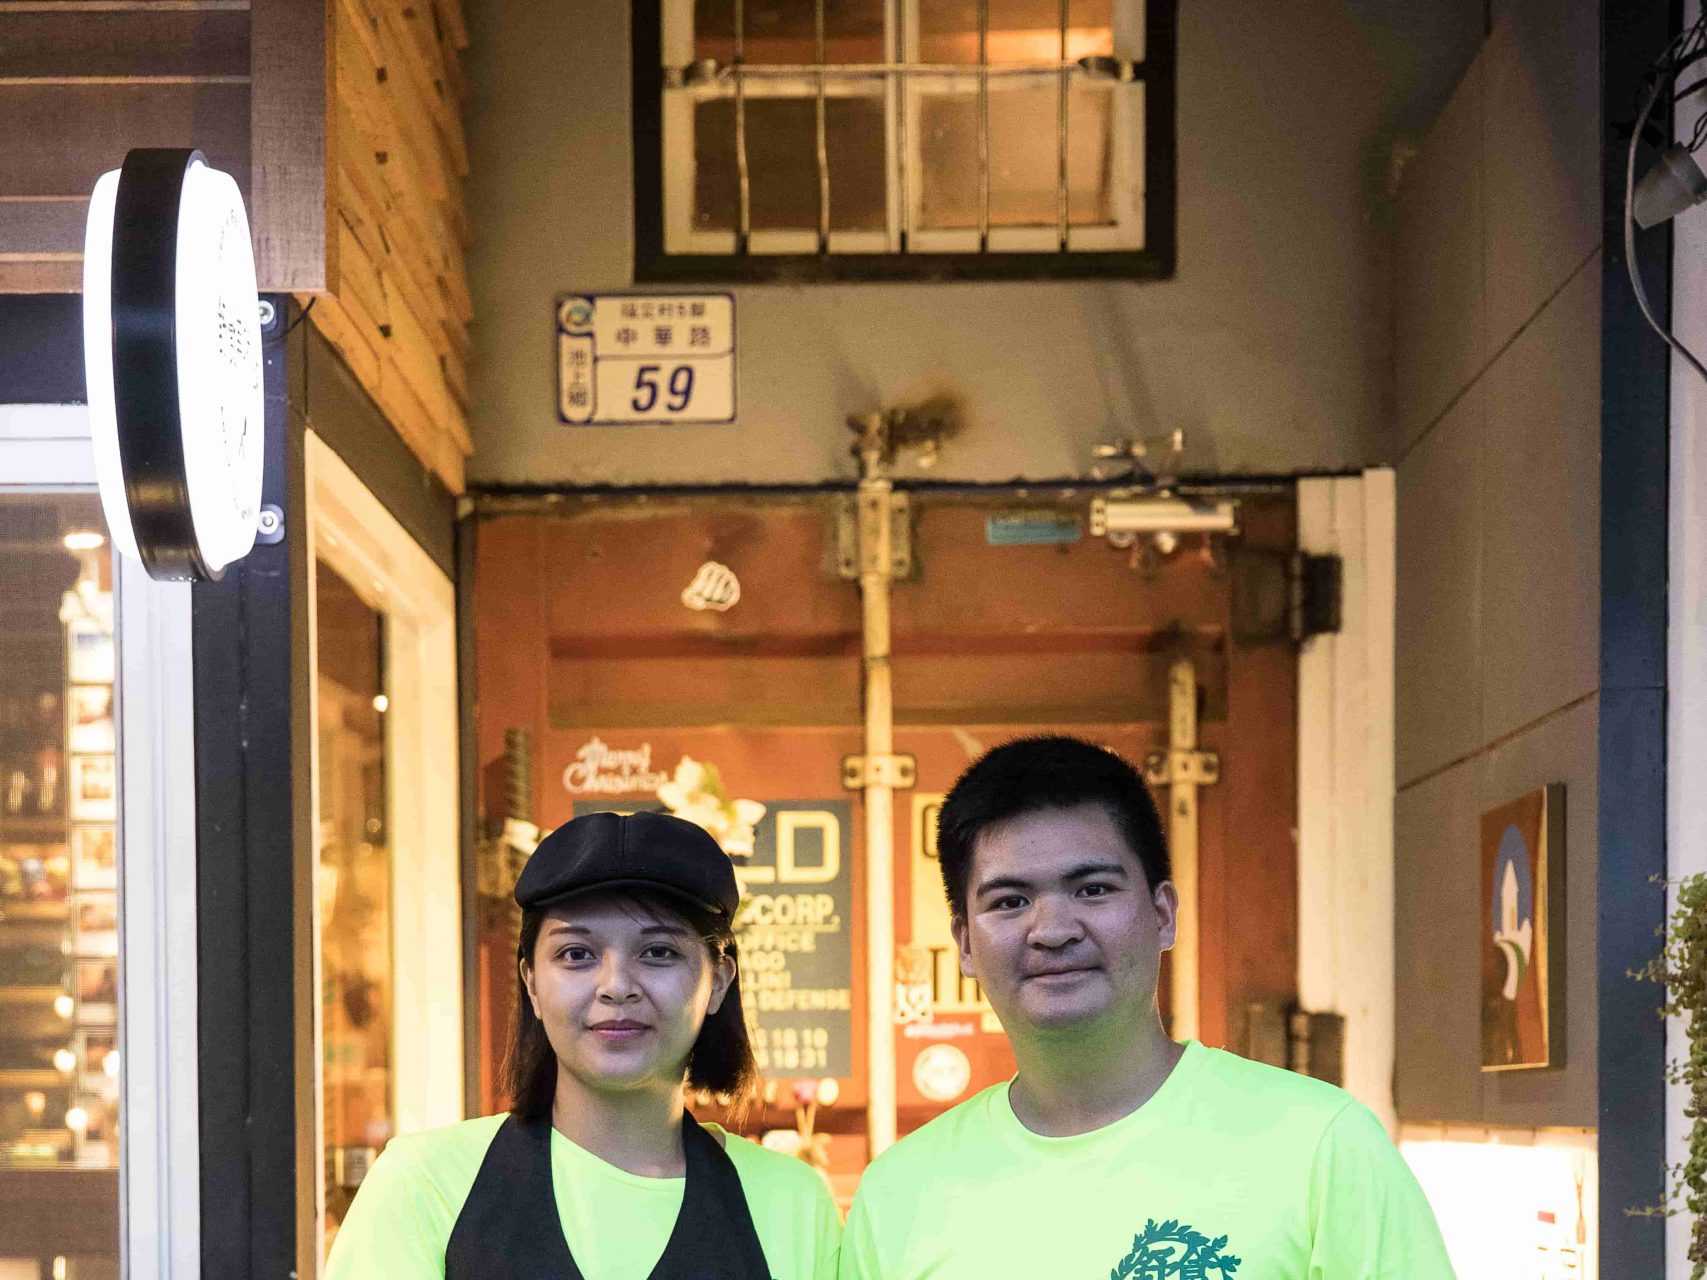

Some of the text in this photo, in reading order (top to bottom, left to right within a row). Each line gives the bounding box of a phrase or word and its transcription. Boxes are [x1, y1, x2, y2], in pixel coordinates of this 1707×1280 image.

[614, 324, 711, 346] 中華路
[631, 365, 695, 413] 59
